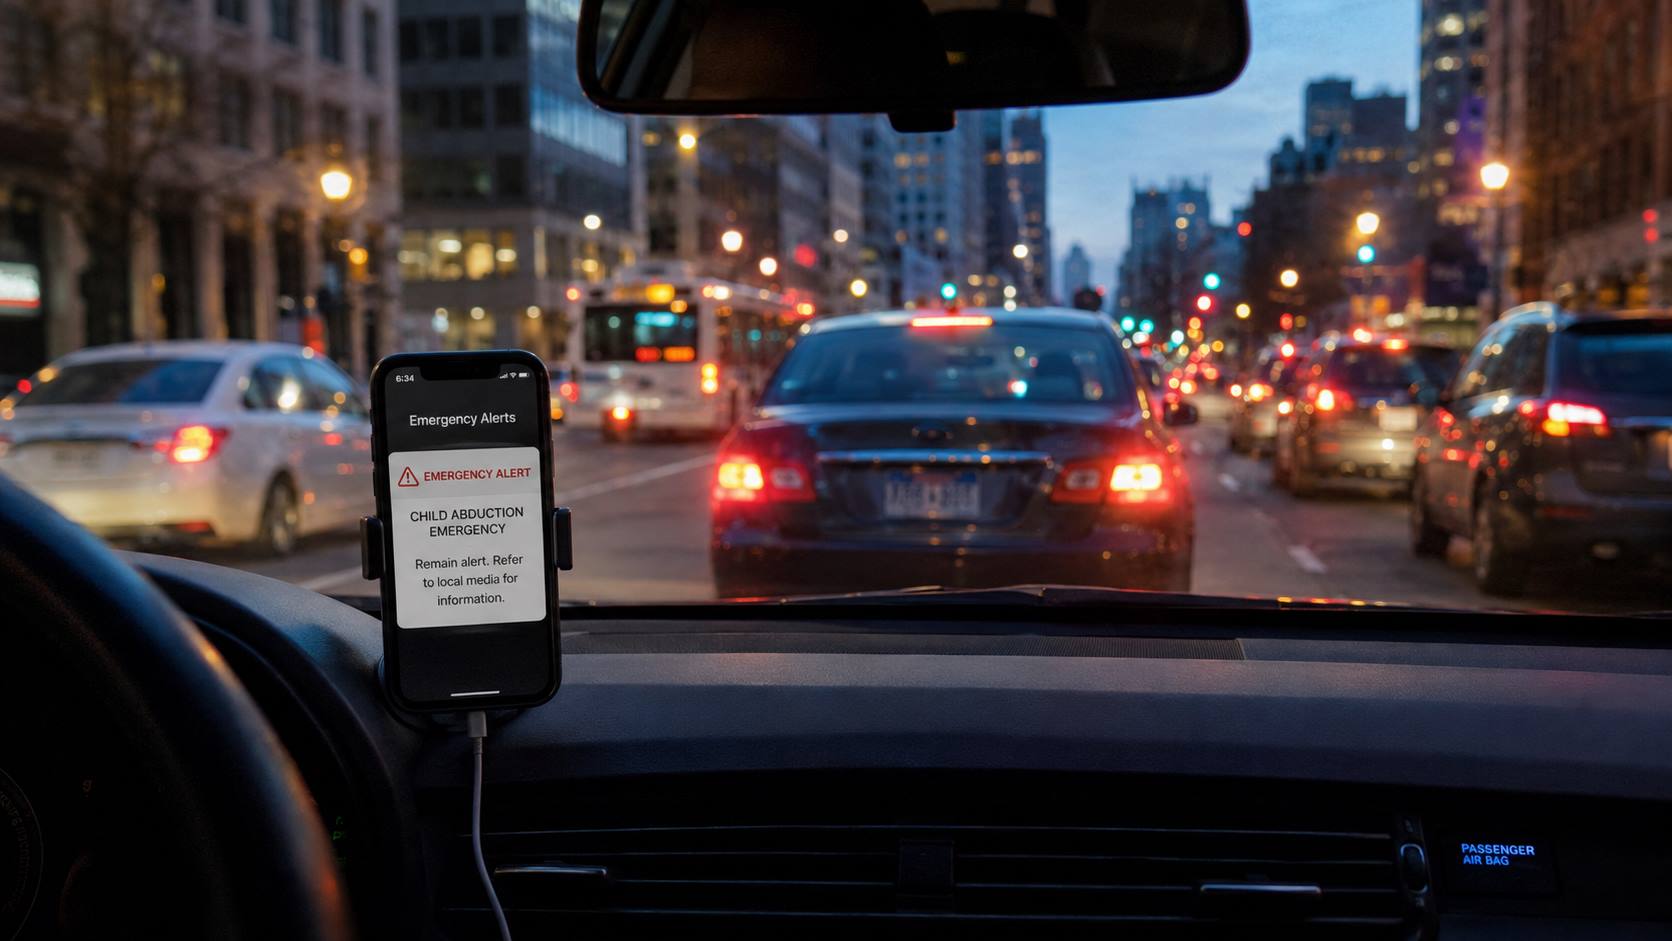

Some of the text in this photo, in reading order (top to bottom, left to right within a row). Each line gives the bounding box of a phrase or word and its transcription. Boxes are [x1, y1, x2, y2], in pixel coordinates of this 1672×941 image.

[396, 374, 415, 383] 6:34
[409, 412, 517, 427] Emergency Alerts
[424, 468, 531, 481] EMERGENCY ALERT
[410, 507, 524, 522] CHILD ABDUCTION
[429, 523, 506, 537] EMERGENCY
[415, 554, 524, 570] Remain alert. Refer
[423, 573, 518, 588] to local media for
[437, 593, 505, 606] information.
[1461, 843, 1535, 856] PASSENGER
[1463, 855, 1509, 866] AIR BAG
